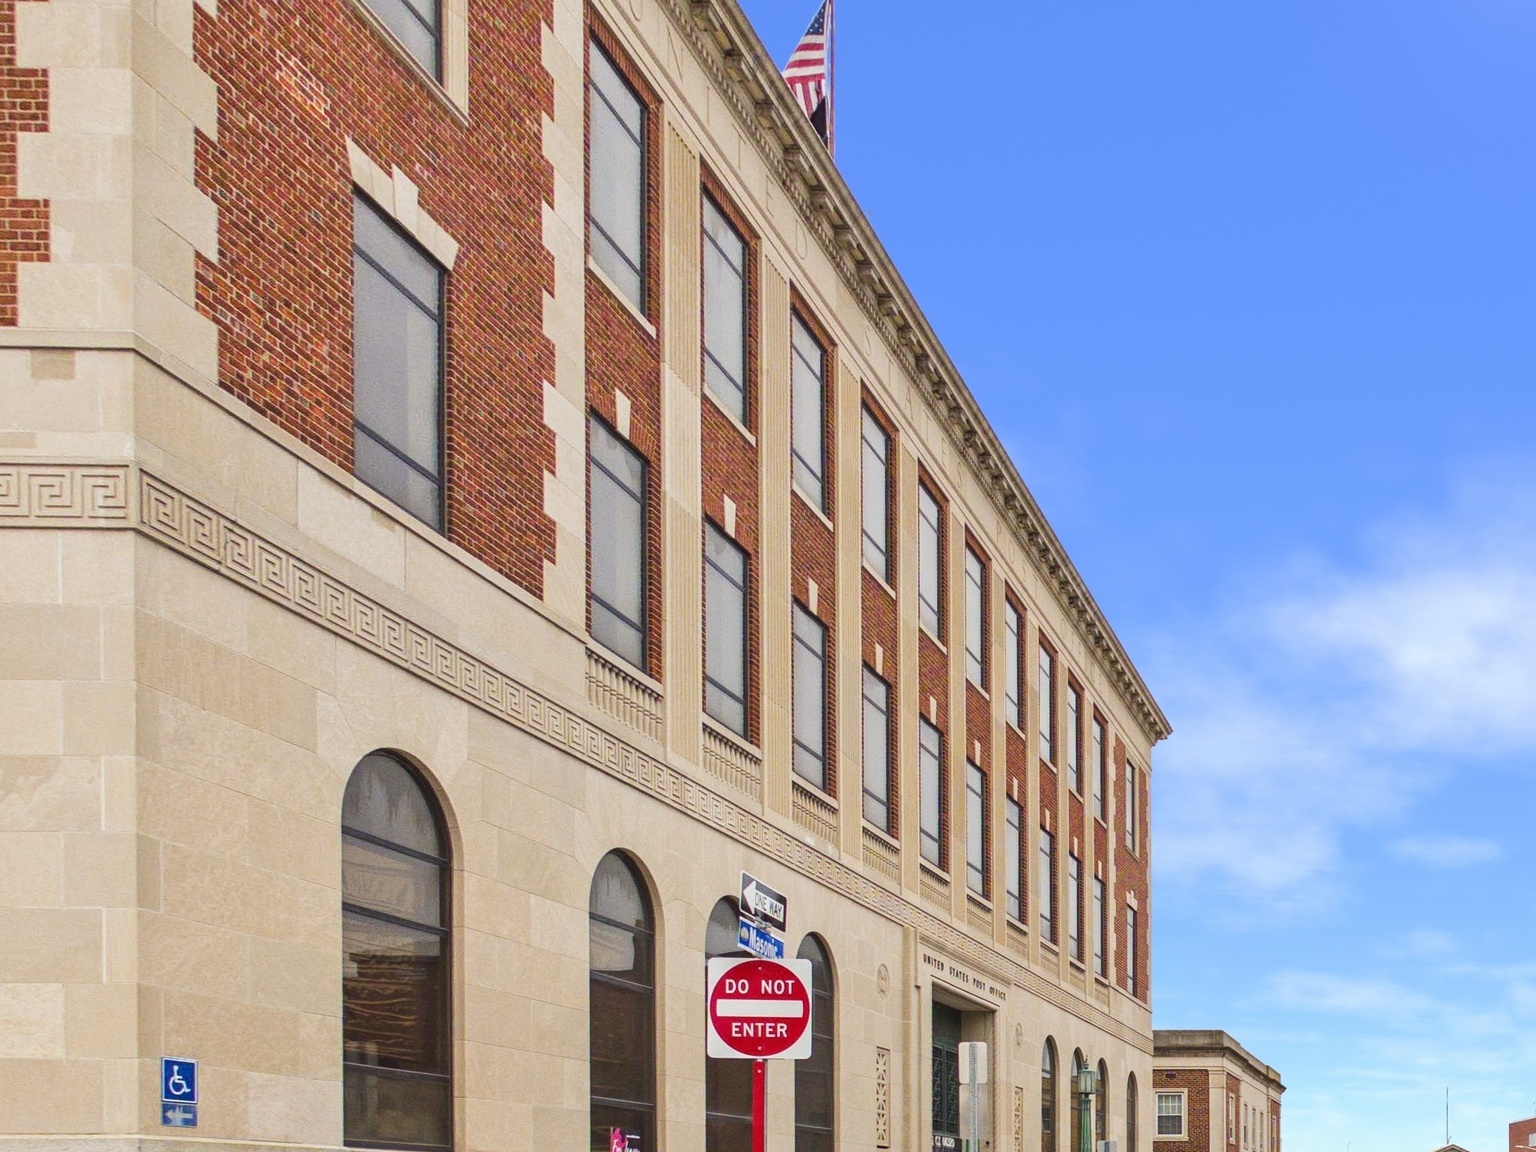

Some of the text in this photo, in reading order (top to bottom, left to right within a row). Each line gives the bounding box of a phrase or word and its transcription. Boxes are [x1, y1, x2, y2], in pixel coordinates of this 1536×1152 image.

[755, 892, 783, 918] ONE WAY
[725, 979, 795, 995] DO NOT
[923, 953, 1006, 1001] UNITED STATES POST OFFICE
[731, 1022, 788, 1038] ENTER
